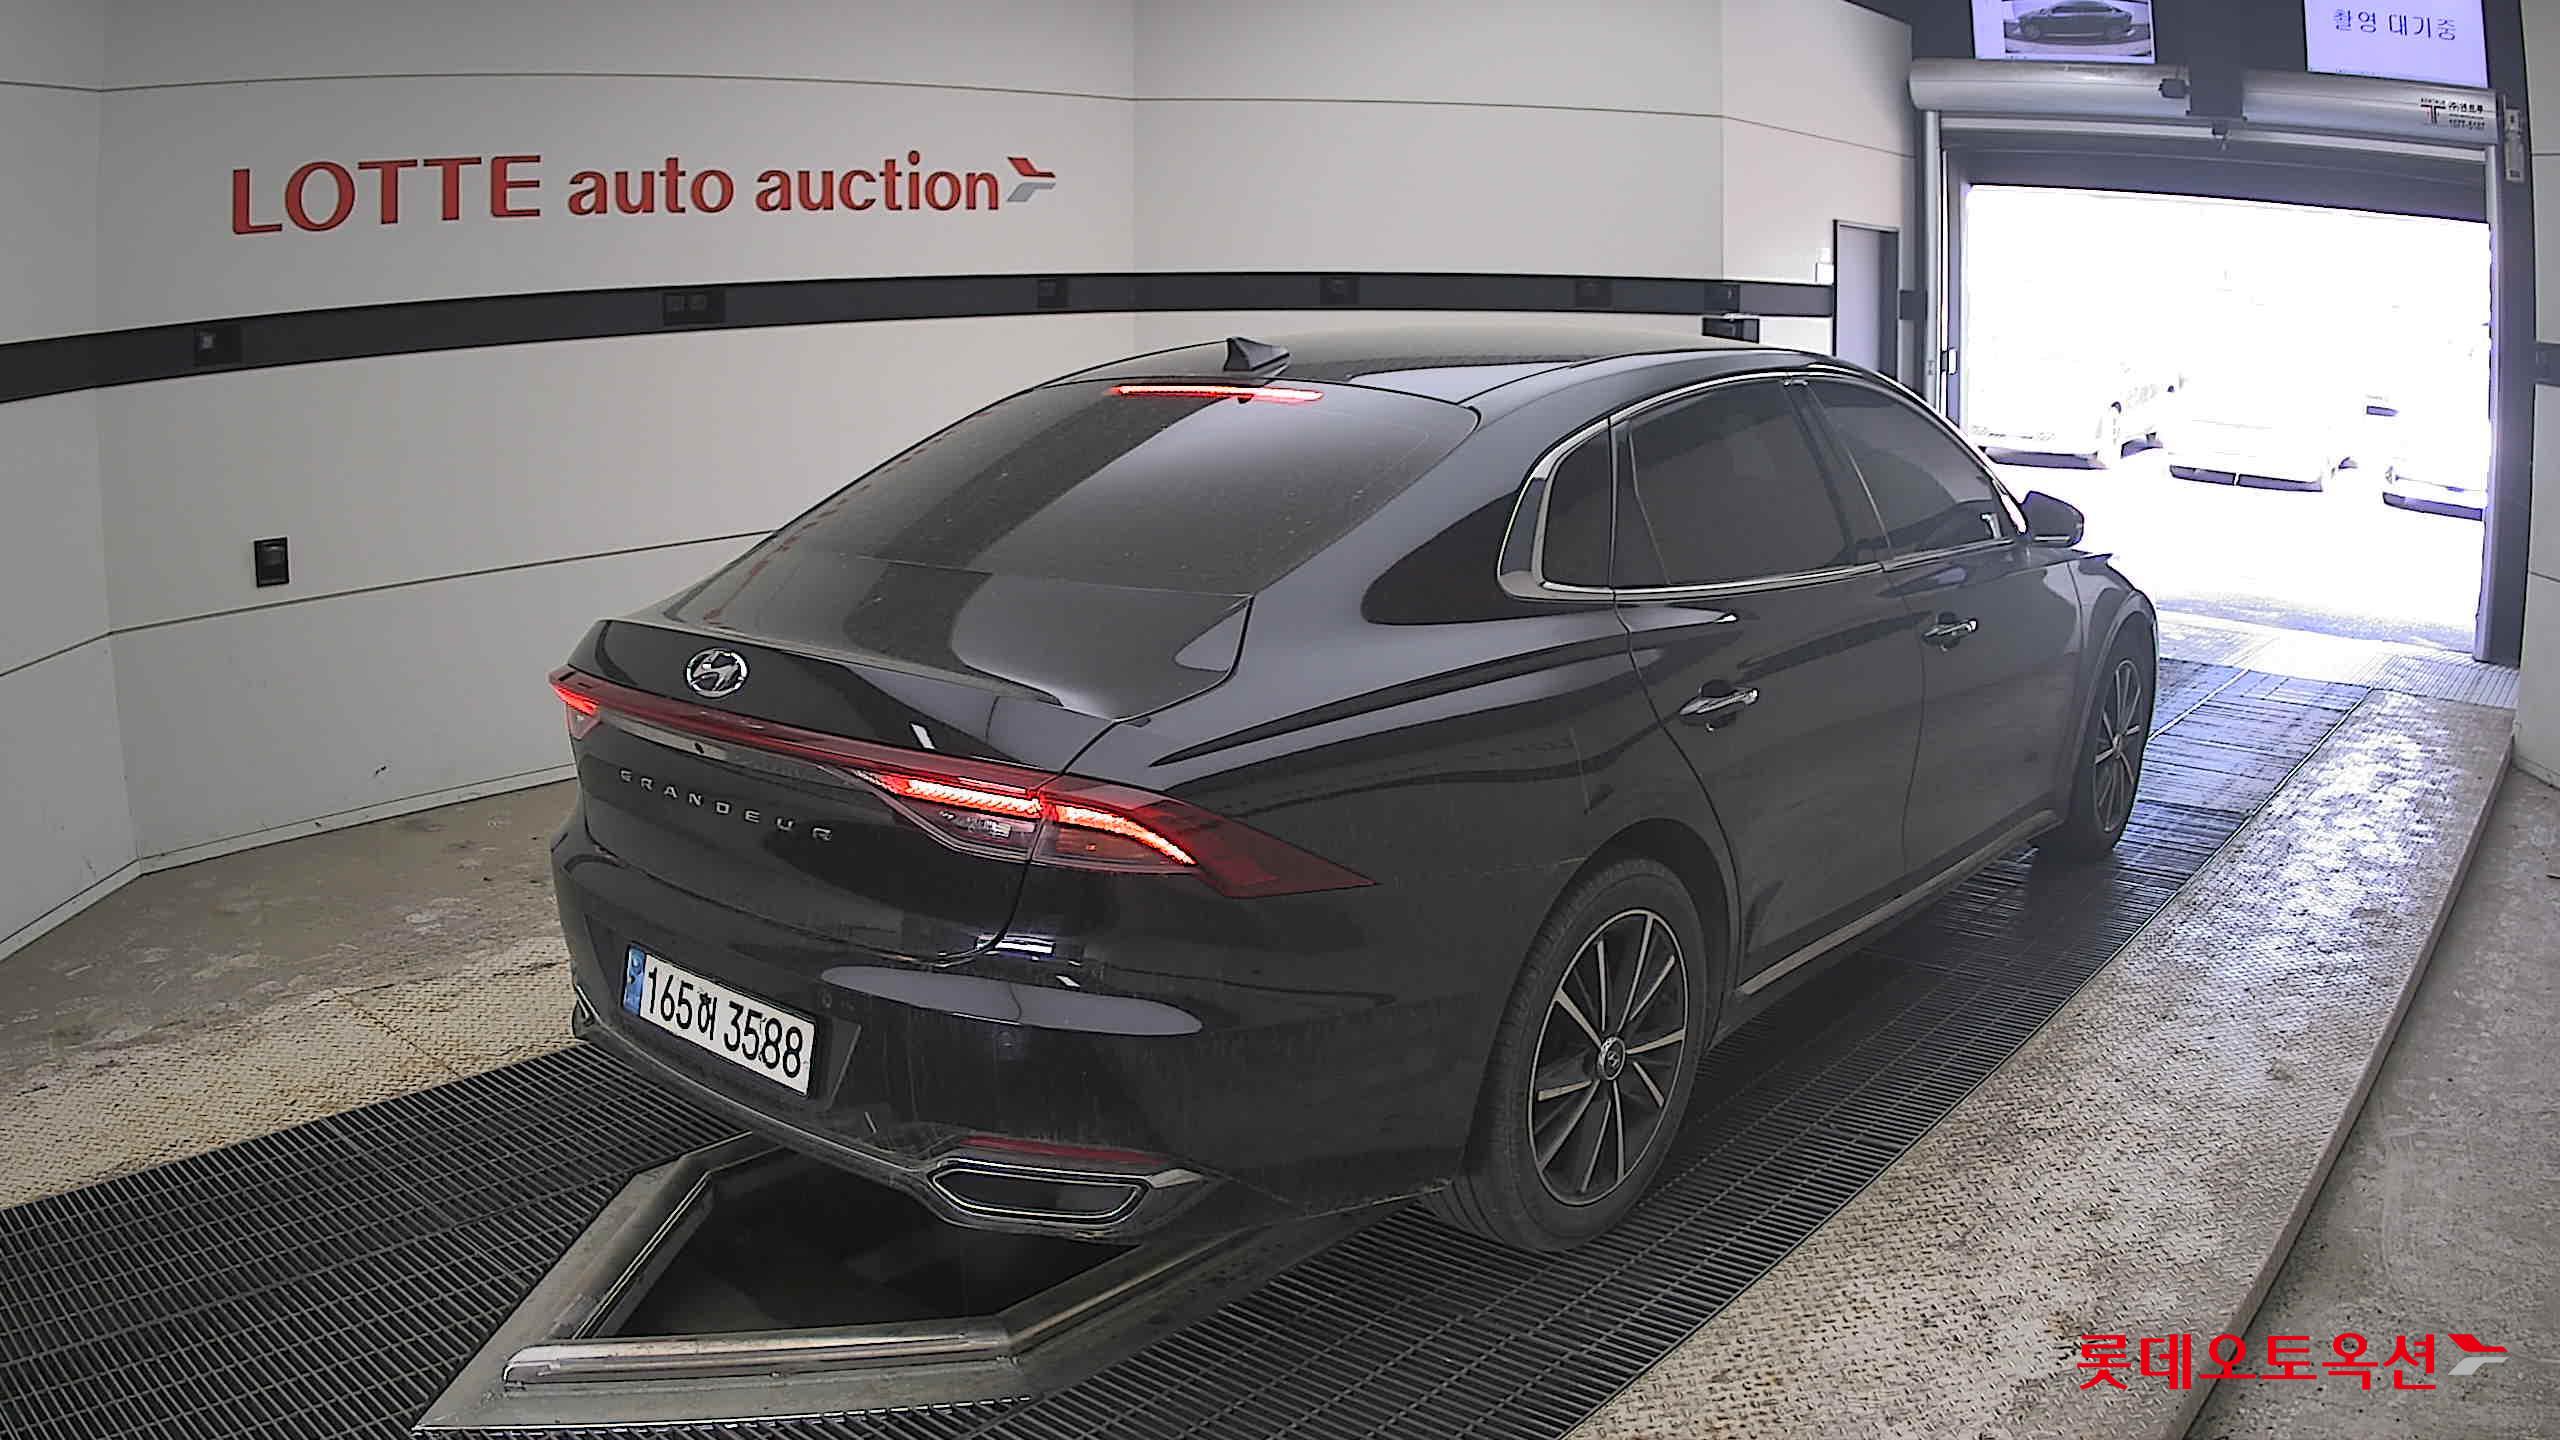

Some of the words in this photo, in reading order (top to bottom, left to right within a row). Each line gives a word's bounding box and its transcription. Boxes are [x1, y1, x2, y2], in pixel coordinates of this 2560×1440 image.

[2388, 13, 2457, 41] 대기중
[232, 154, 541, 235] LOTTE
[566, 156, 735, 215] auto
[755, 149, 1000, 213] auction
[619, 769, 833, 842] GRANDEUR
[648, 966, 719, 1041] 165허
[723, 1000, 804, 1078] 3588
